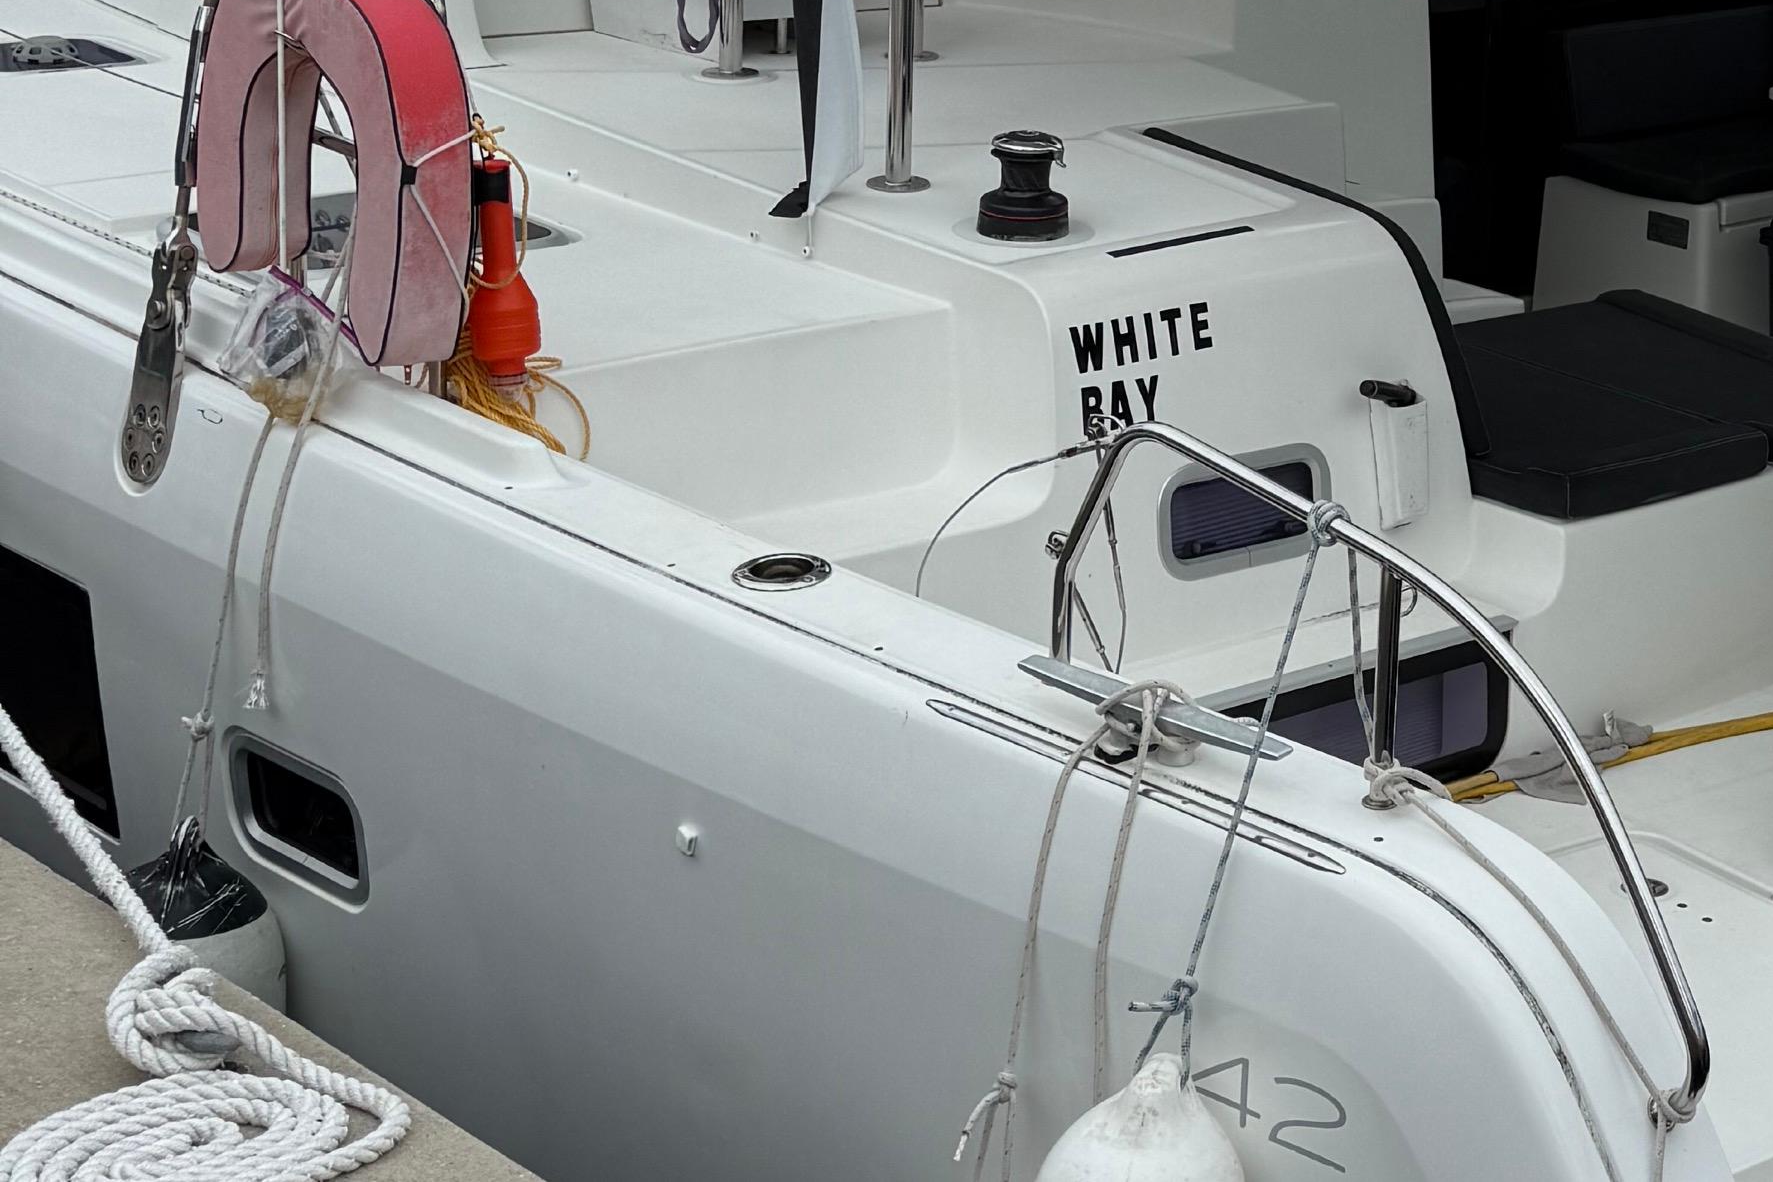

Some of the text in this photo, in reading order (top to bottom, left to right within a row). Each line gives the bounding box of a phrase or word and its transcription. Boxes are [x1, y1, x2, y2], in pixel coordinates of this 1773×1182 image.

[1069, 302, 1213, 374] WHITE
[1080, 375, 1158, 436] BAY
[1190, 1057, 1347, 1174] 42
